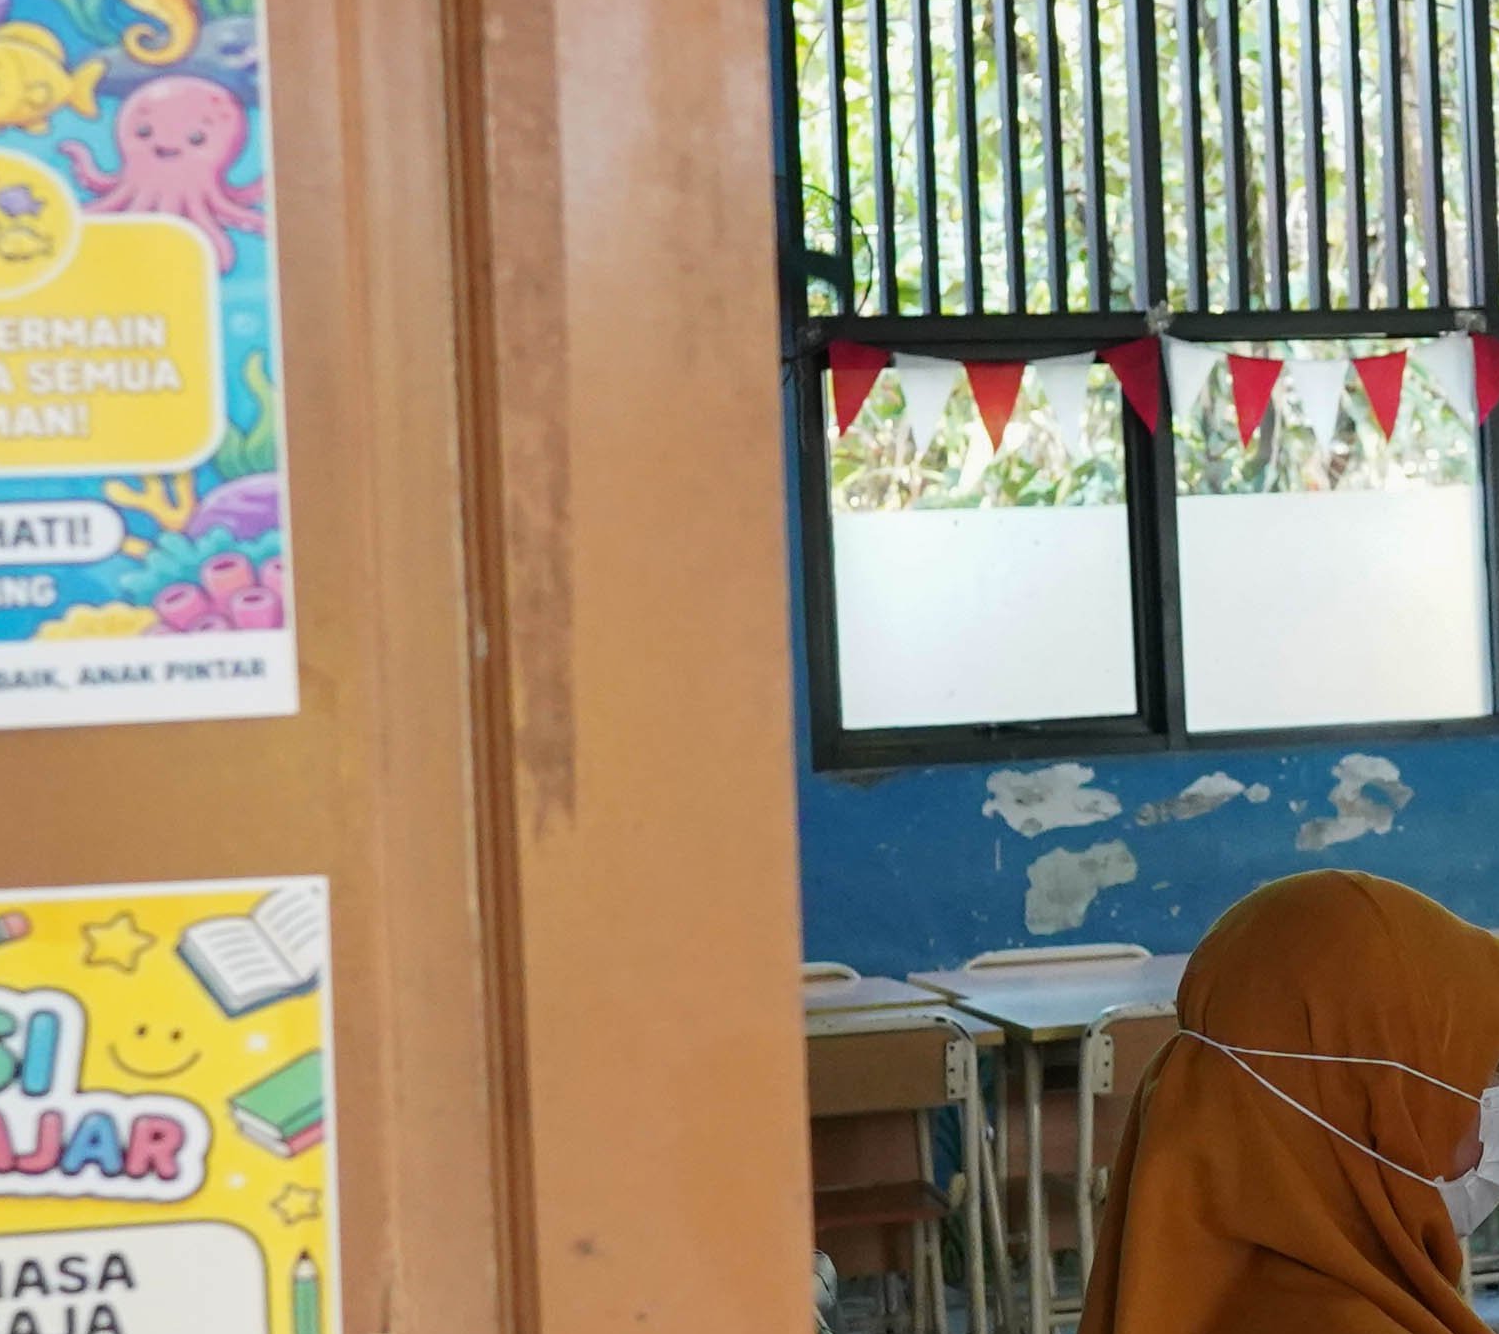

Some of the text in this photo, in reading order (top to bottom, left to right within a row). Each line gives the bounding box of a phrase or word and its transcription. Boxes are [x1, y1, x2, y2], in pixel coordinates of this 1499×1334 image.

[29, 359, 182, 395] SEMUA
[79, 663, 154, 686] ANAK
[165, 658, 266, 681] PINTAR
